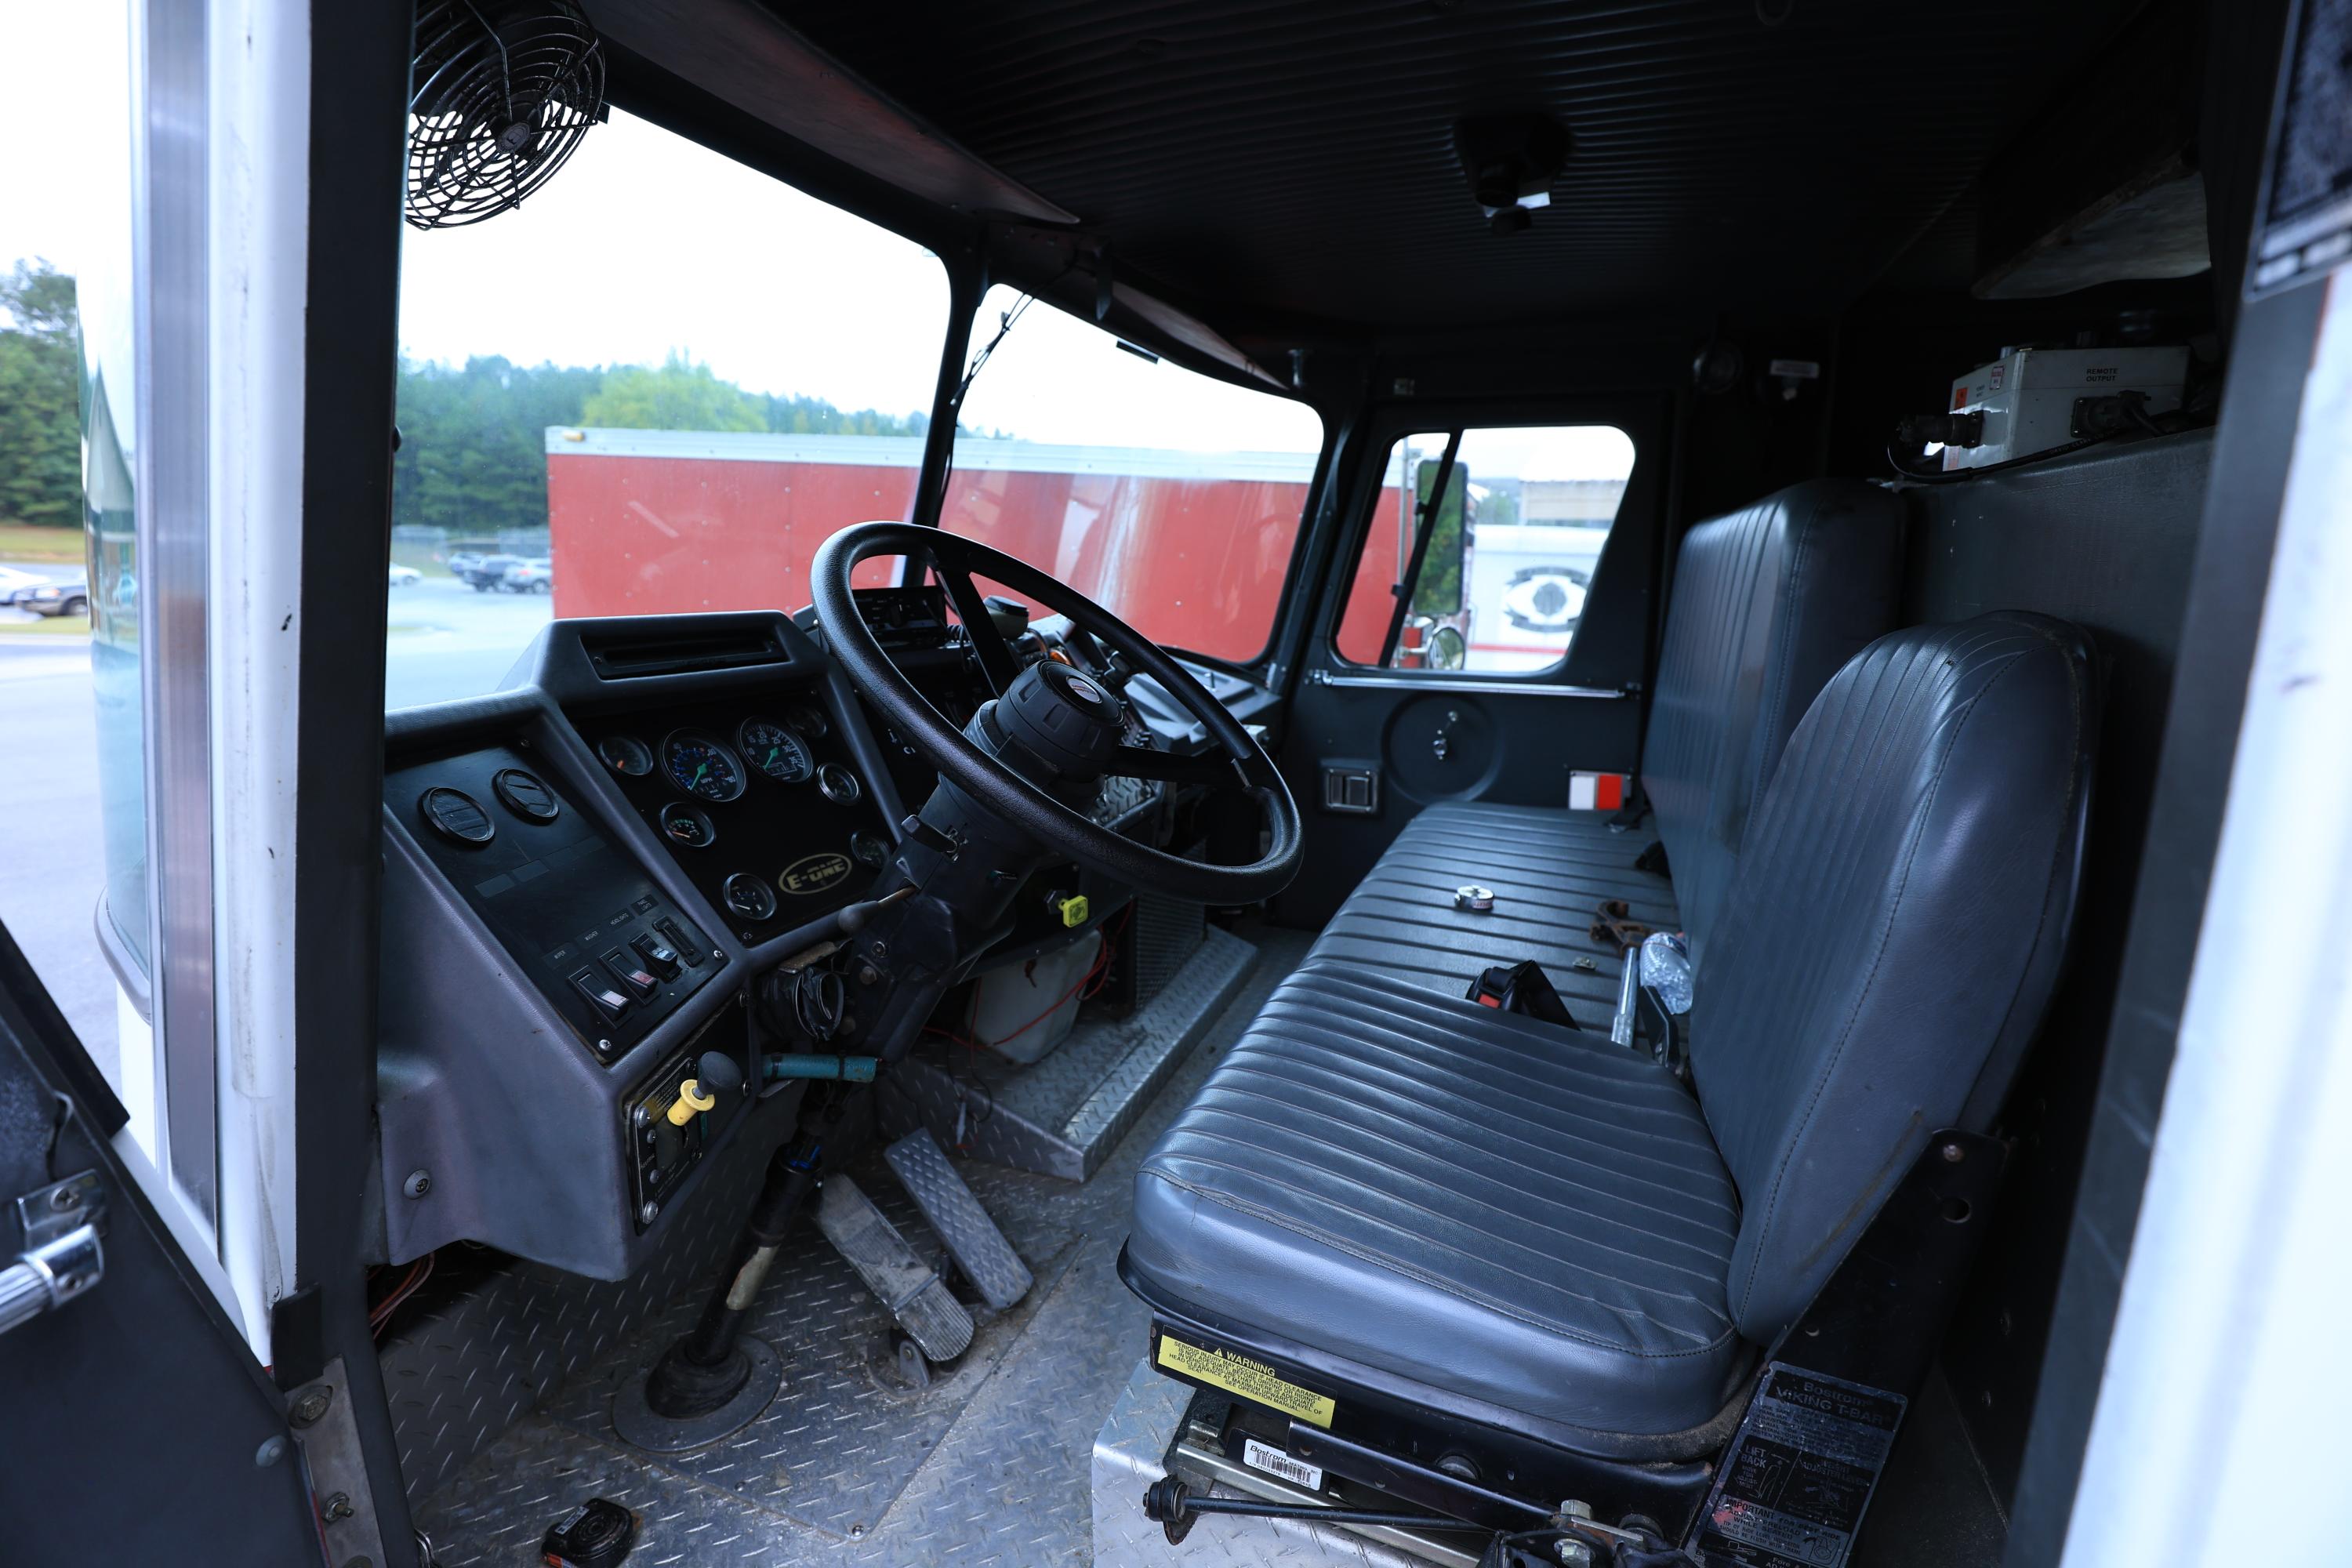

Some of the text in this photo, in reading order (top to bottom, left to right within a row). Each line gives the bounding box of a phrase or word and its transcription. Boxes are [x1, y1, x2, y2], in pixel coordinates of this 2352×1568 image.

[786, 858, 846, 890] E-ONE
[1174, 1341, 1199, 1355] SERIOUS
[1200, 1351, 1221, 1363] INJURY
[1222, 1359, 1234, 1368] MAY
[1236, 1365, 1258, 1377] OCCUR
[1265, 1376, 1283, 1386] HEAD
[1283, 1383, 1322, 1401] CLEARANCE
[1226, 1351, 1276, 1377] WARNING
[1169, 1353, 1185, 1363] HEAD
[1186, 1359, 1221, 1377] CLEARANCE
[1232, 1377, 1260, 1392] MAXIMUM
[1261, 1388, 1287, 1403] UPWARD
[1289, 1399, 1312, 1412] TRAVEL
[1212, 1365, 1236, 1377] ENSURE
[1236, 1374, 1250, 1383] THAT
[1254, 1381, 1272, 1392] THERE
[1281, 1392, 1314, 1407] ADEQUATE
[1232, 1368, 1255, 1381] BEFORE
[1258, 1377, 1282, 1391] DRIVING
[1294, 1392, 1315, 1403] RIDING
[1237, 1384, 1272, 1401] OPERATION
[1776, 1385, 1833, 1410] VIKING
[1250, 1445, 1287, 1463] Bostrom
[1740, 1454, 1767, 1468] BACK
[1745, 1445, 1766, 1457] LIFT
[1726, 1497, 1775, 1519] IMPORTANT
[1779, 1518, 1798, 1529] FOR
[1821, 1529, 1840, 1541] RIDE
[1730, 1508, 1801, 1536] ADJUST PRELOAD
[1733, 1517, 1758, 1529] WHILE
